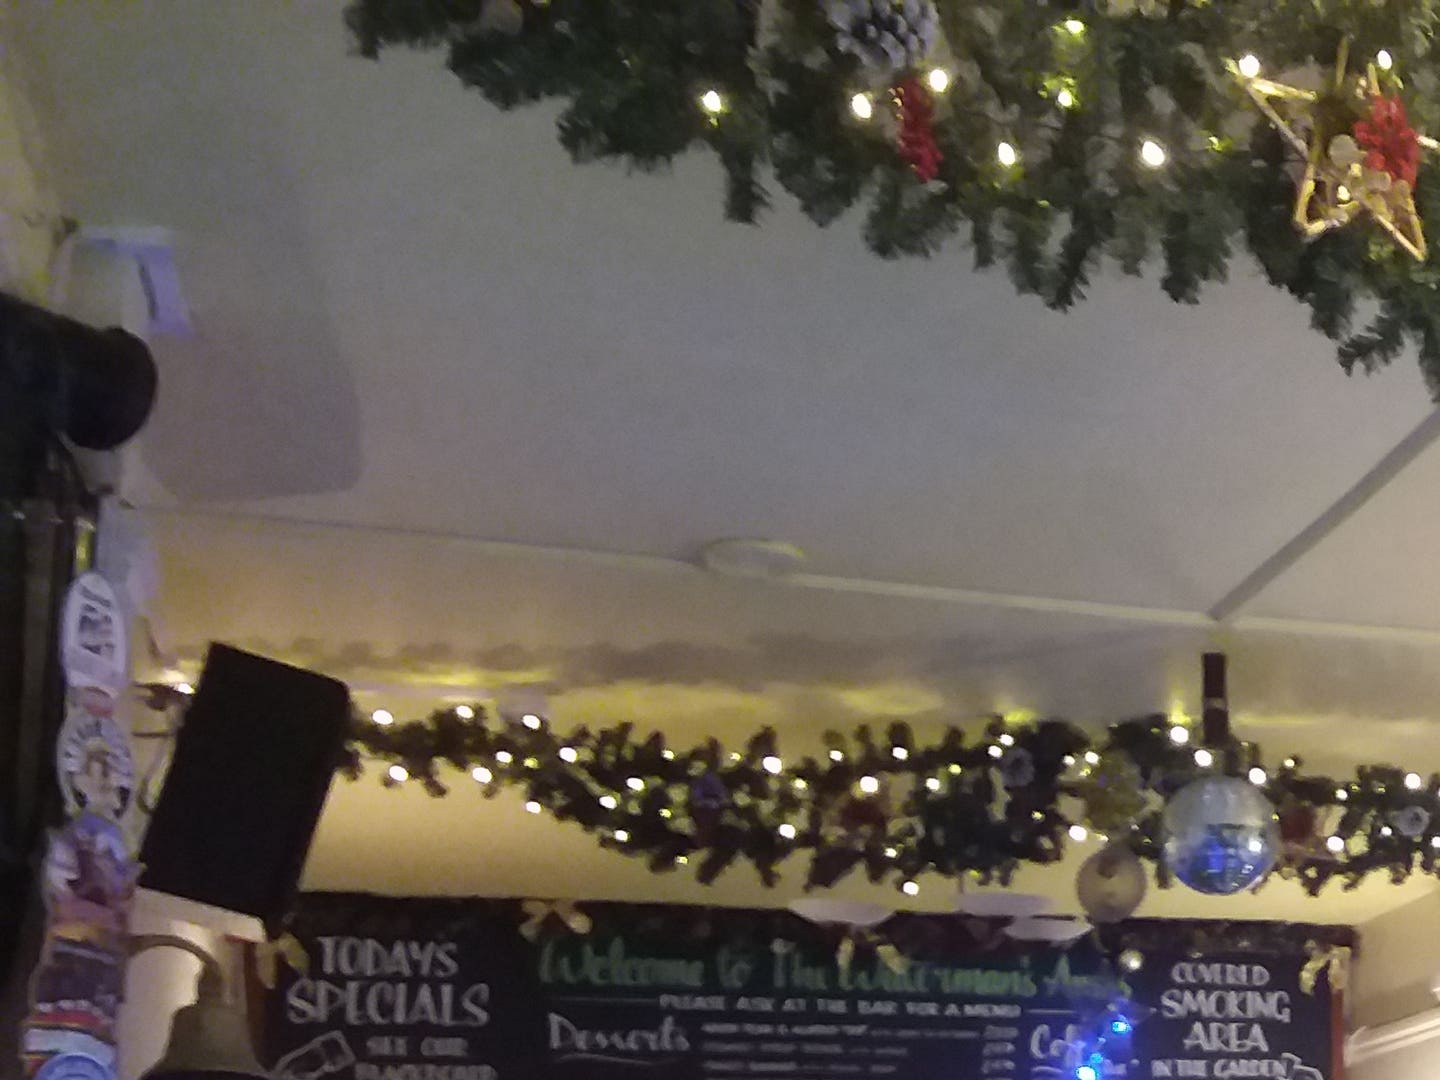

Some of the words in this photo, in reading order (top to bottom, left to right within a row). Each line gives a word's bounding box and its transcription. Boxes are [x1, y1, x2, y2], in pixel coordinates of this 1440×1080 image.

[287, 980, 490, 1026] SPECIALS
[1160, 988, 1291, 1024] SMOKING
[1183, 1020, 1271, 1053] AREA
